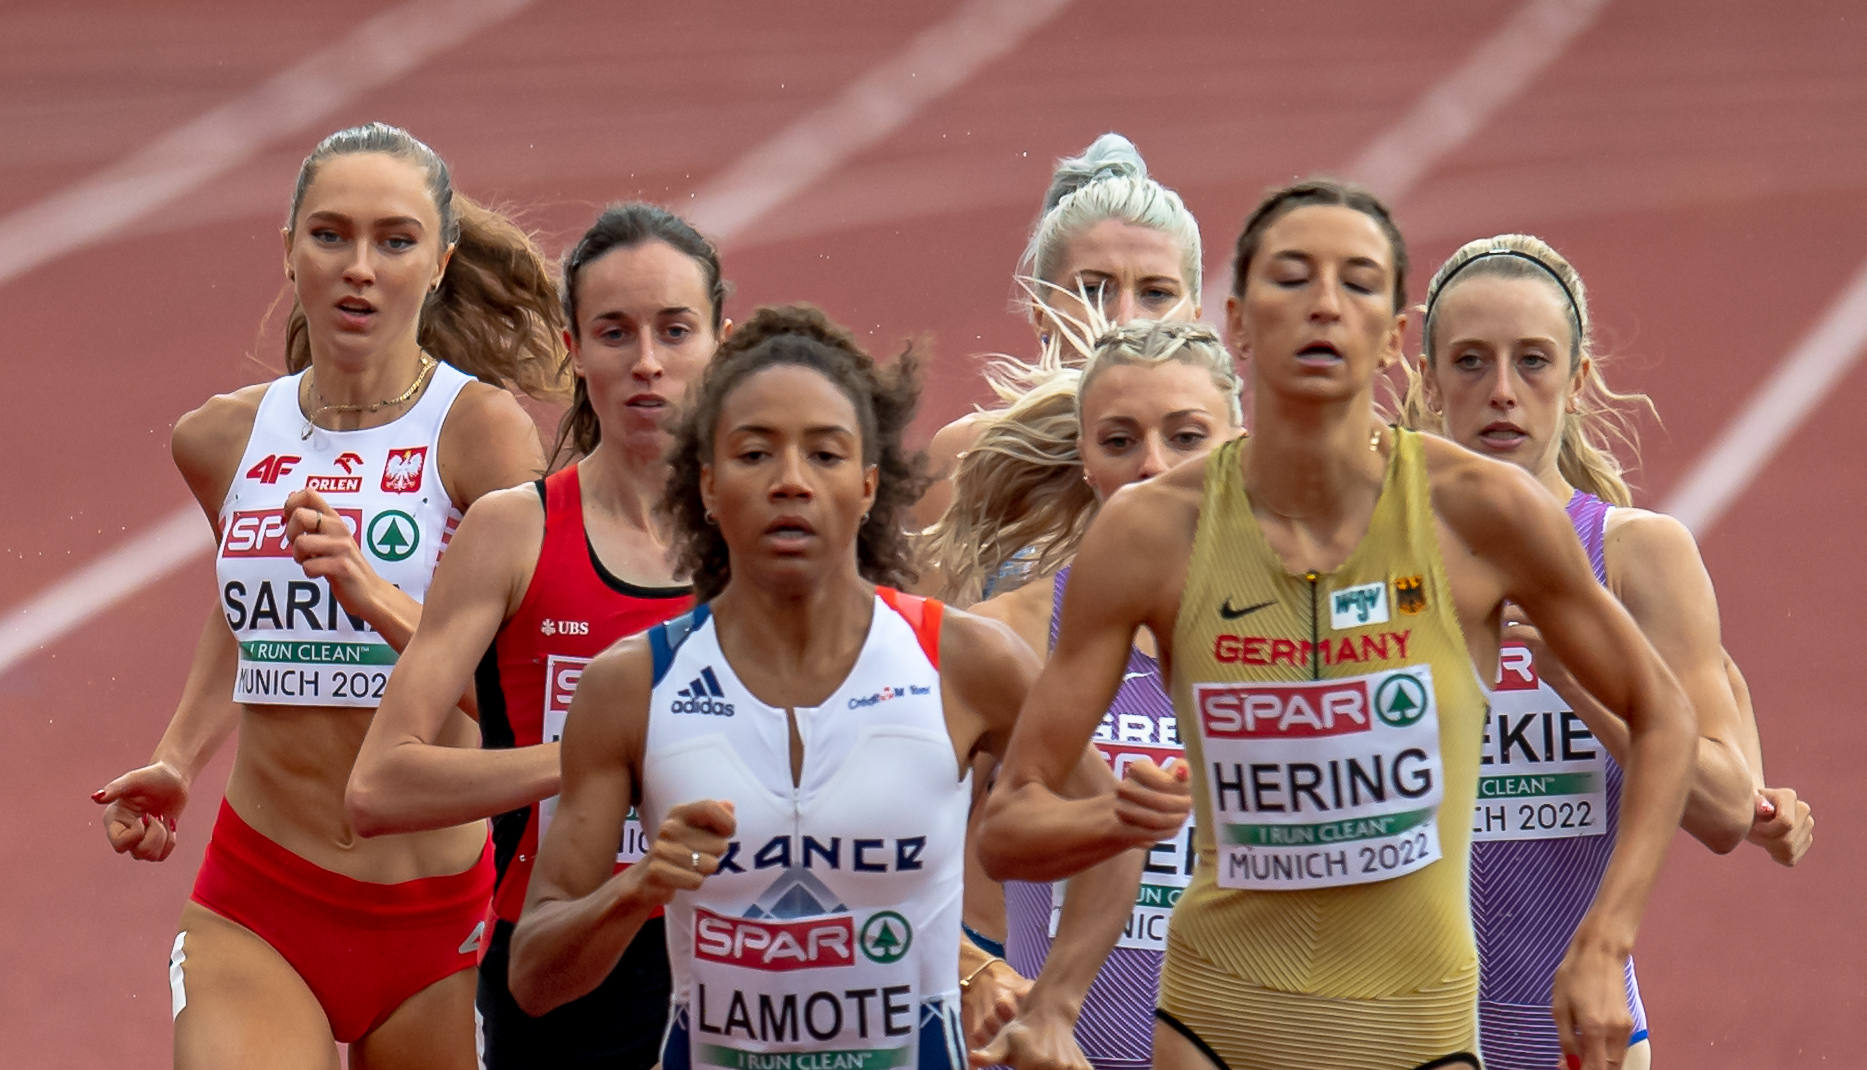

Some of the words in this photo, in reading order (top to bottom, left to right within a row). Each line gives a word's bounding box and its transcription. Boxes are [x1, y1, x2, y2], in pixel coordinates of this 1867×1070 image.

[246, 454, 302, 484] 4F
[308, 478, 359, 491] ORLEN
[558, 621, 590, 636] UBS
[257, 643, 293, 660] RUN
[1214, 629, 1412, 667] GERMANY
[238, 668, 319, 697] MUNICH
[332, 672, 387, 698] 202
[671, 698, 735, 717] adidas
[1206, 690, 1366, 732] SPAR
[1213, 748, 1433, 813] HERING
[1518, 801, 1593, 831] 2022
[1260, 827, 1267, 843] I
[1270, 826, 1315, 844] RUN
[711, 834, 927, 875] RANCE
[1229, 850, 1348, 881] MUNICH
[1358, 833, 1429, 874] 2022
[699, 918, 850, 963] SPAR
[698, 983, 912, 1042] LAMOTE
[749, 1054, 792, 1070] RUN
